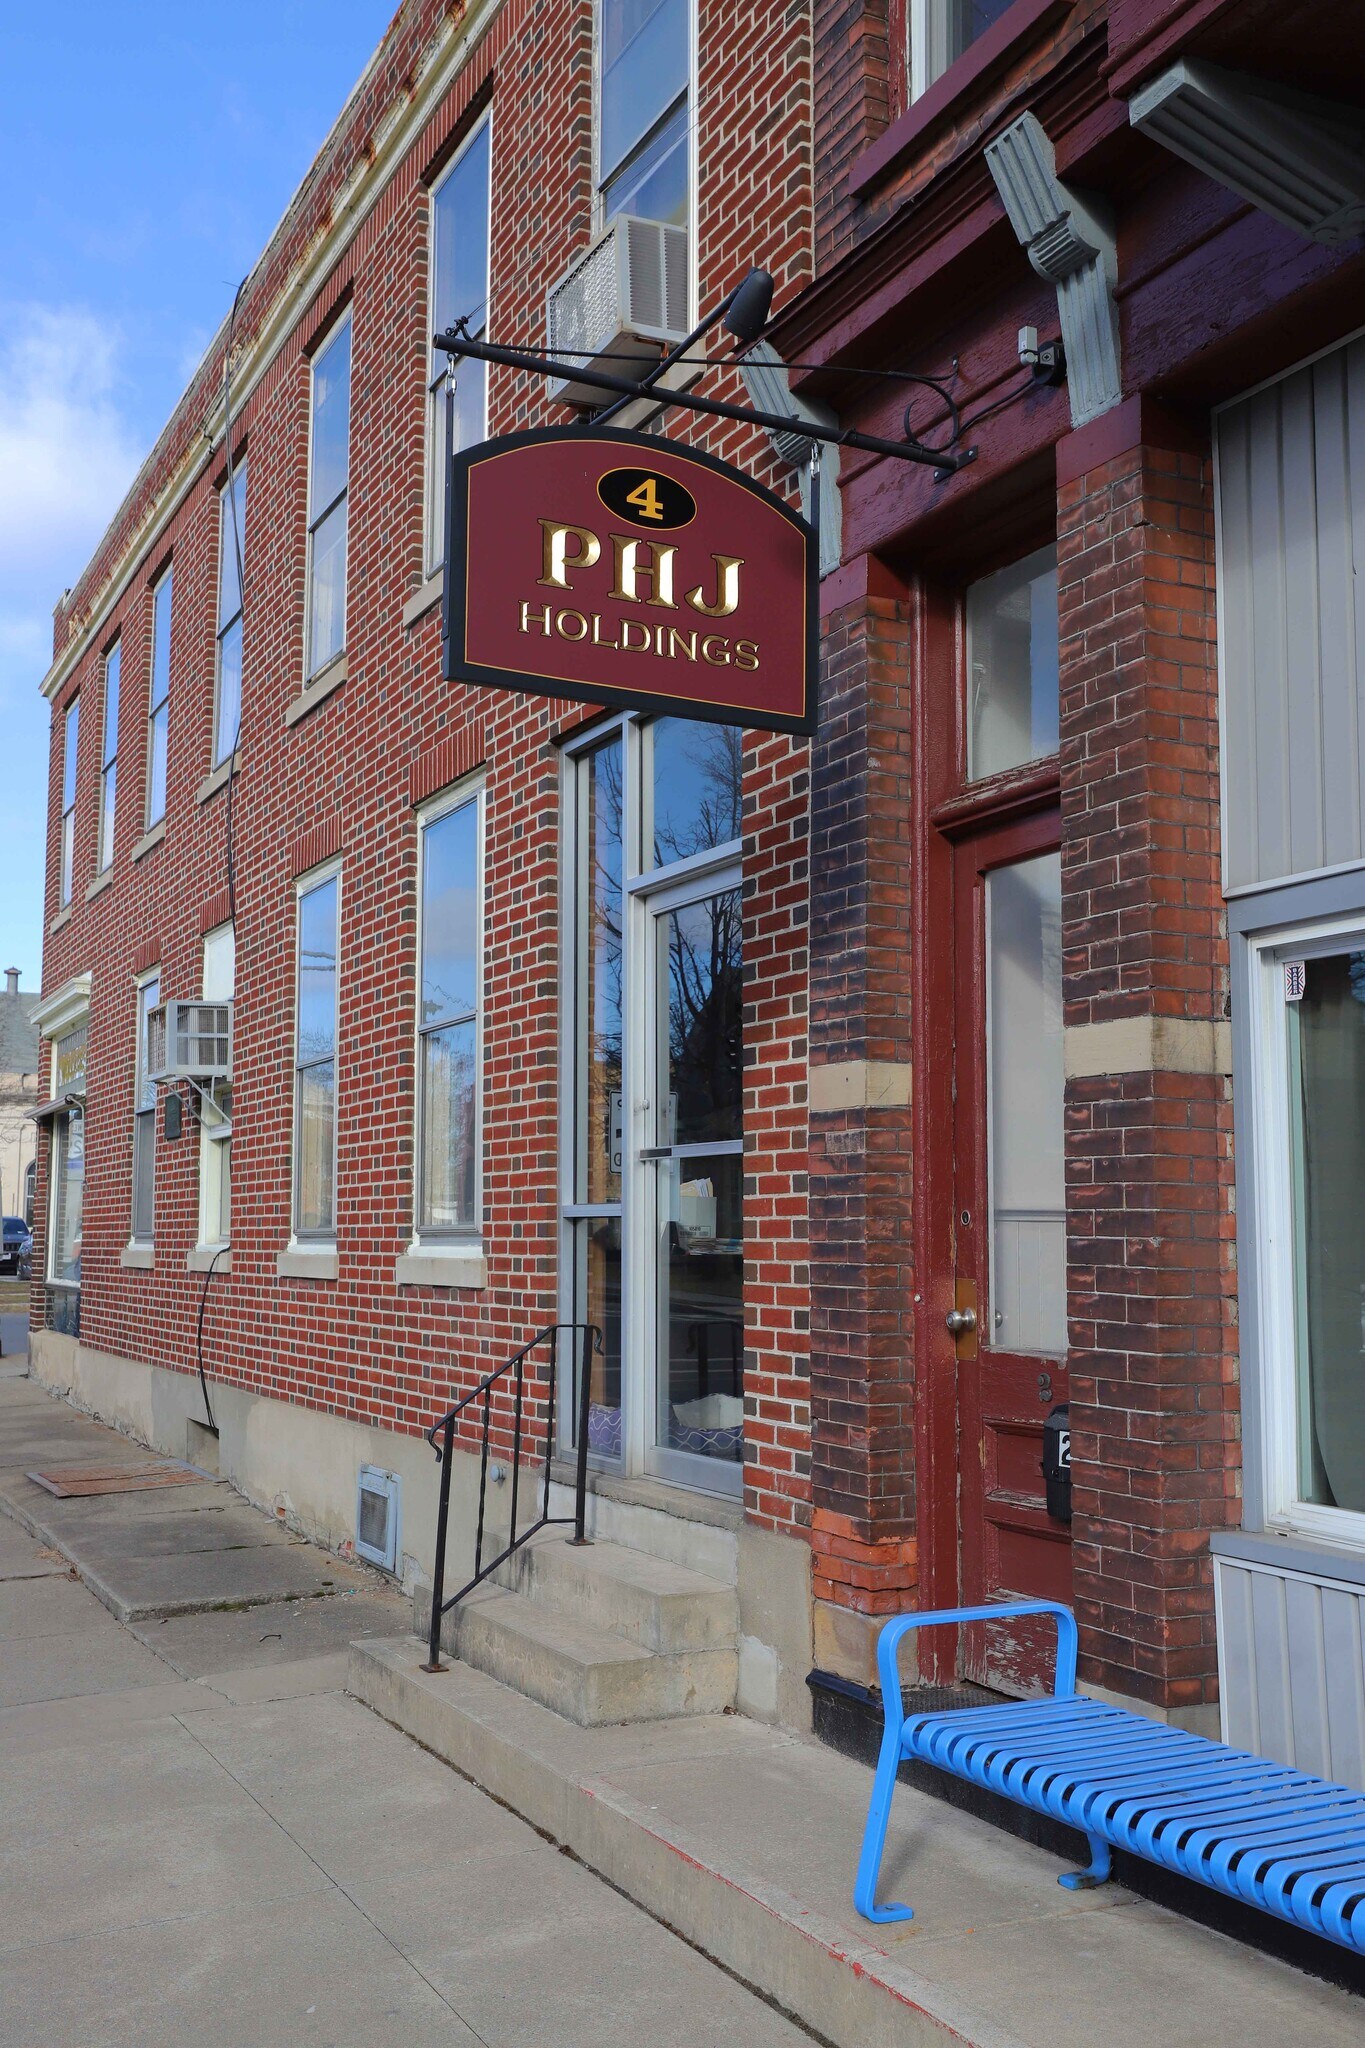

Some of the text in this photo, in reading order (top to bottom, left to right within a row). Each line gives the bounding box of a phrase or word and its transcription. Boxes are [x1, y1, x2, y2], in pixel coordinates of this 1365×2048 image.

[626, 478, 664, 520] 4
[537, 517, 745, 618] PHJ
[518, 600, 760, 672] HOLDINGS
